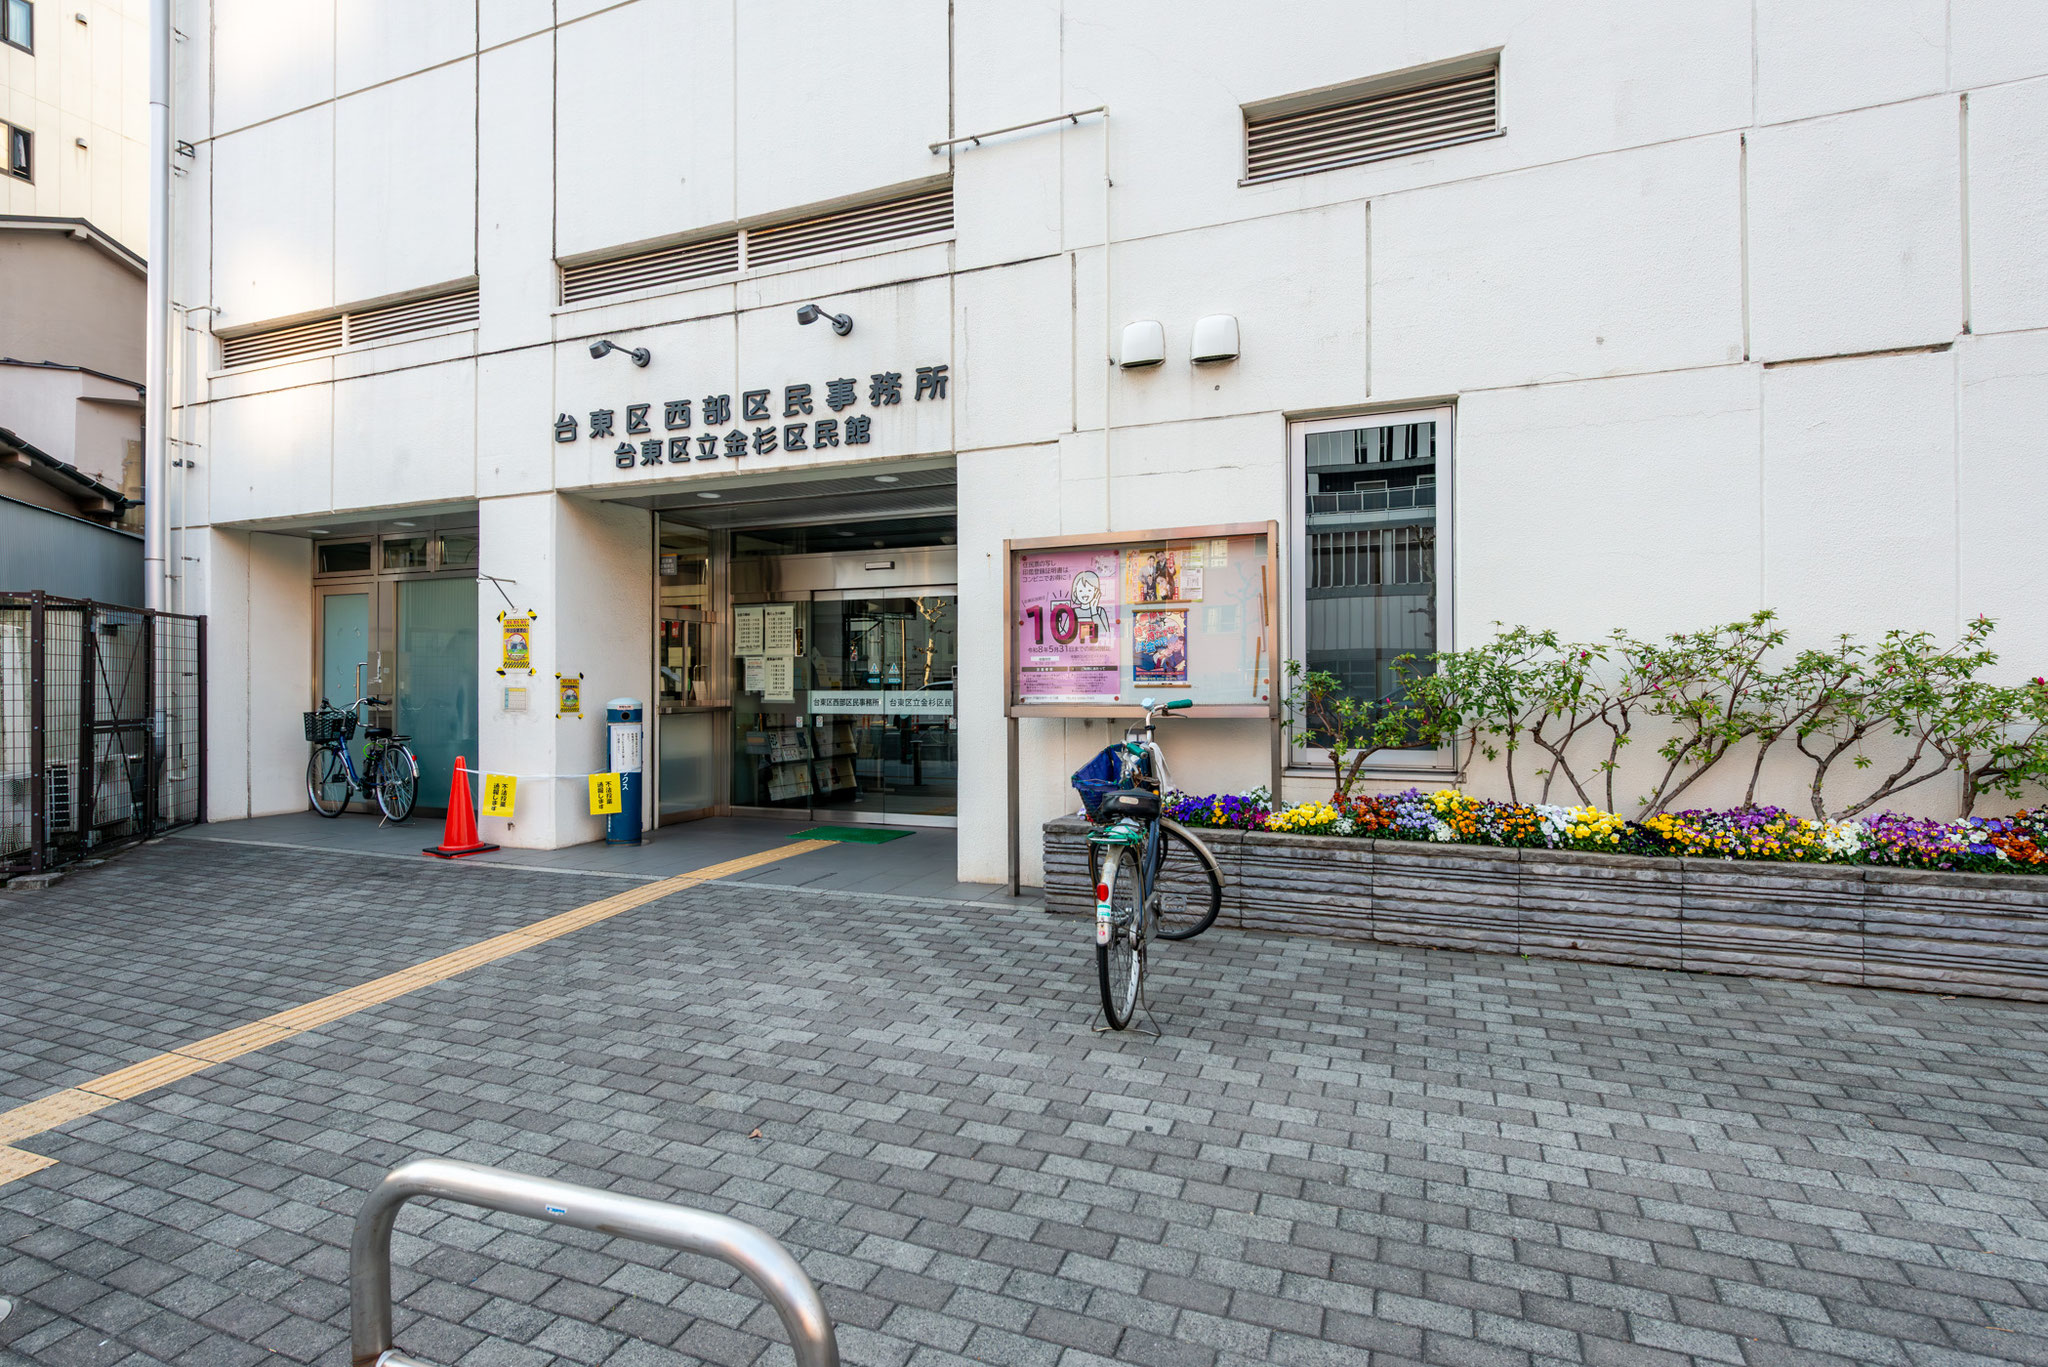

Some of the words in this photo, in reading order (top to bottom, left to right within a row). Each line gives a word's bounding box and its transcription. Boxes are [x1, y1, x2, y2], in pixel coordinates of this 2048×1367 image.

[554, 364, 949, 443] 台東区西部区民事務所
[614, 414, 872, 469] 台東区立金杉区民館
[813, 698, 880, 707] 台東区西部区民事務所
